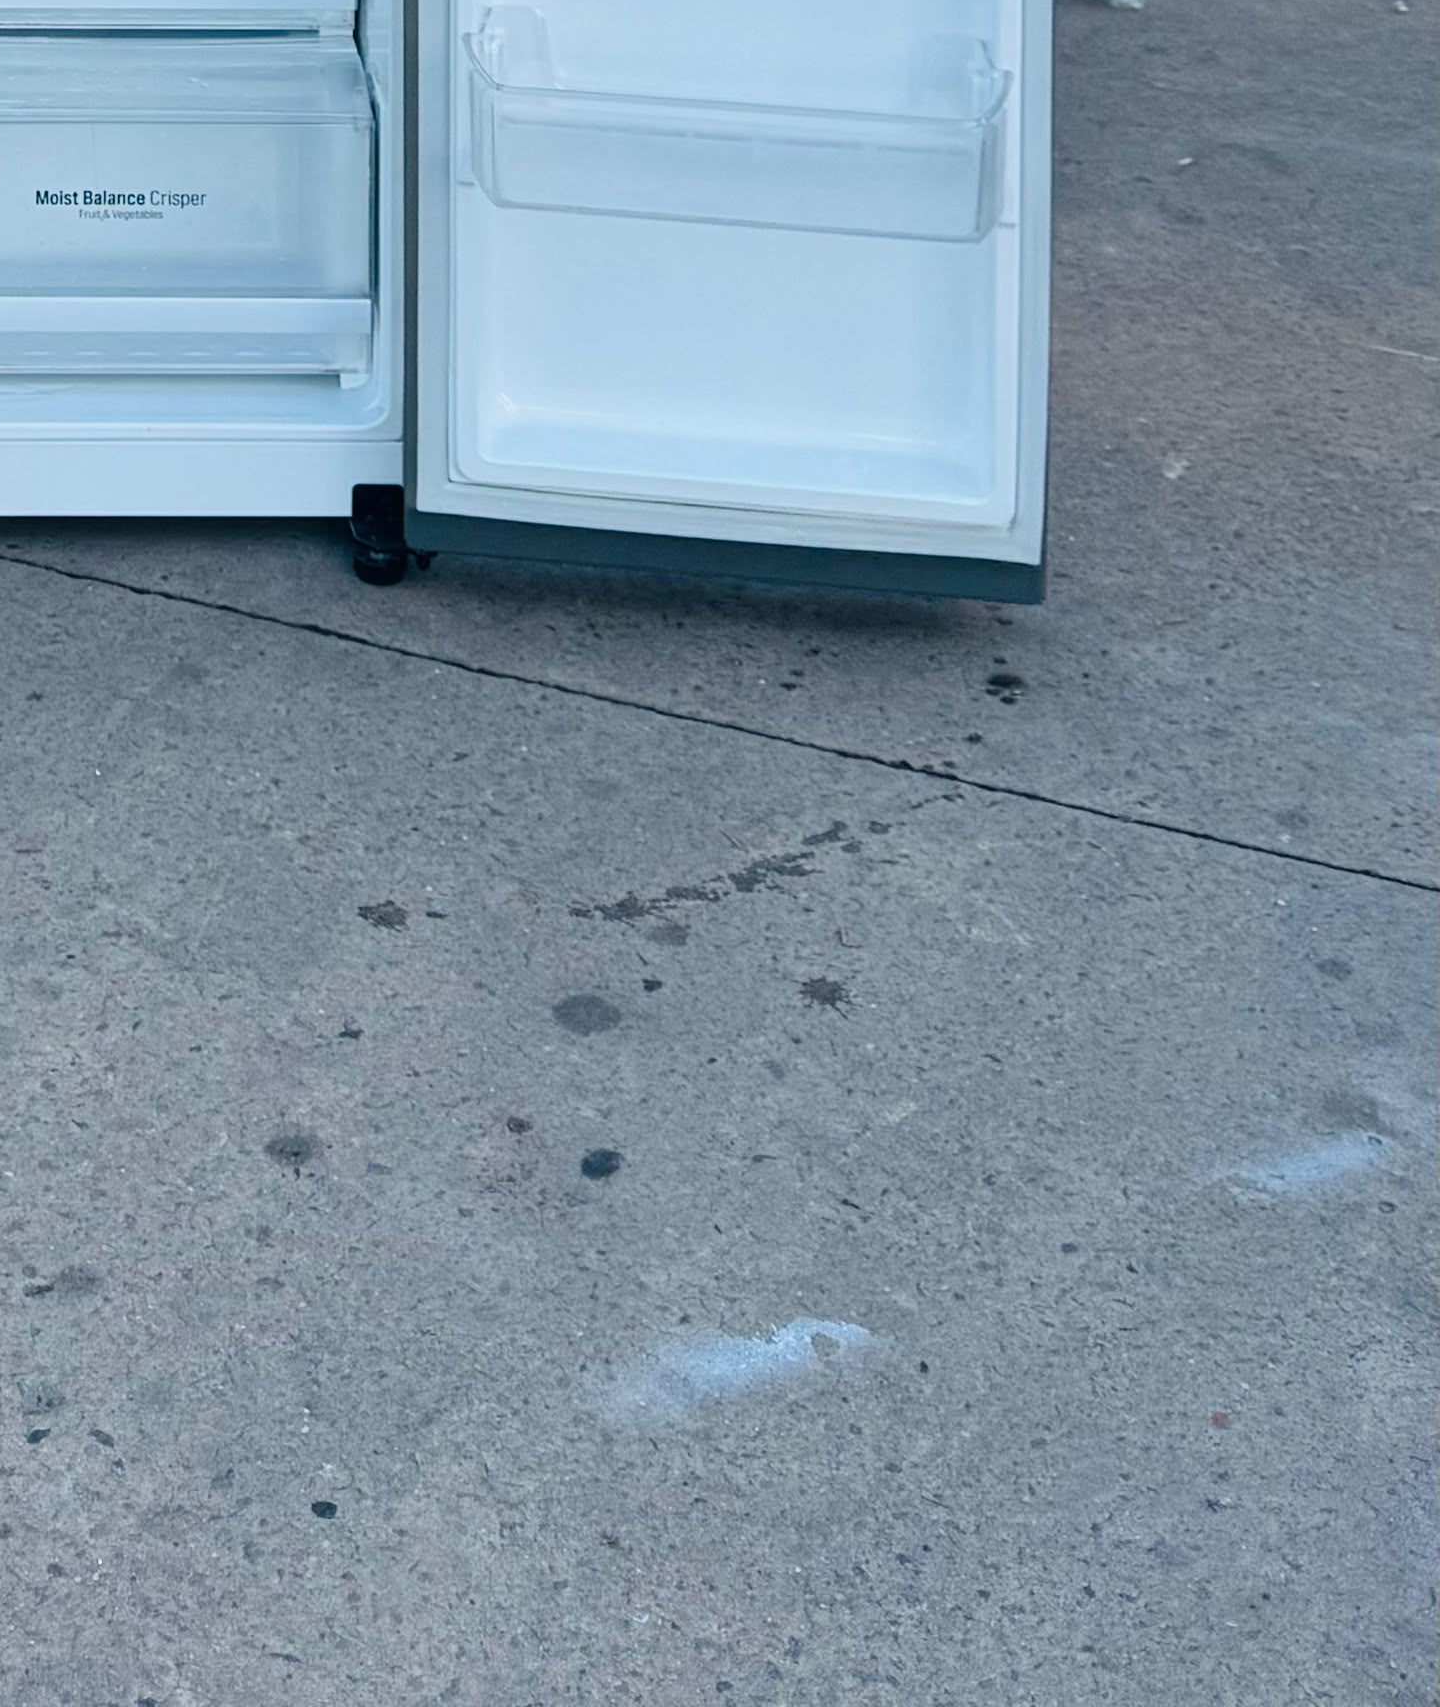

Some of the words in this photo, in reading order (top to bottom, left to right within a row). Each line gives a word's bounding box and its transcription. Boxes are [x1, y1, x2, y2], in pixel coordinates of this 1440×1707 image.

[35, 190, 79, 206] Moist
[82, 190, 146, 206] Balance
[149, 190, 207, 209] Crisper
[78, 209, 101, 221] Fruit
[111, 209, 164, 221] Vegetables
